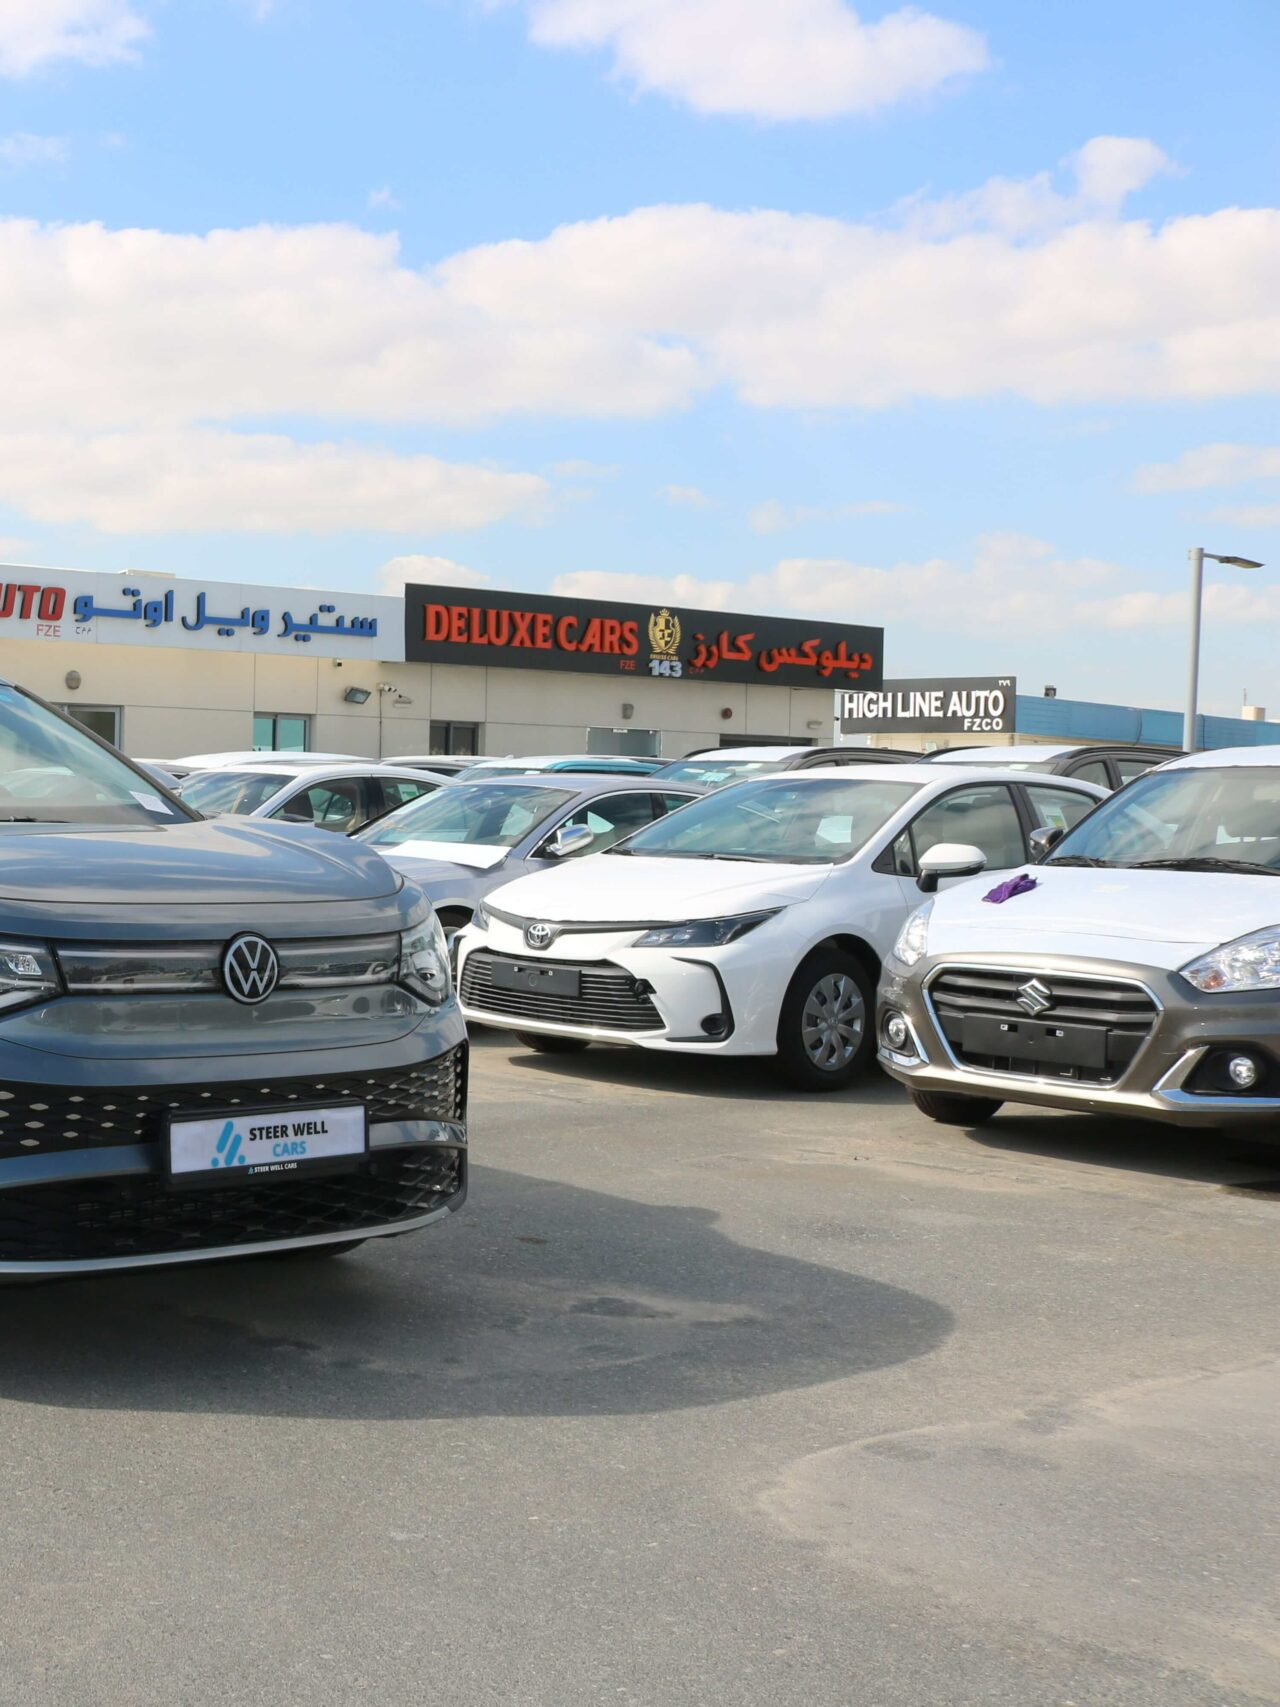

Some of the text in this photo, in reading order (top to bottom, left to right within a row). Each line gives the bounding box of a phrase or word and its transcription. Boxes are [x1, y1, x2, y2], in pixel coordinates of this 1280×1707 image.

[74, 587, 378, 642] ستير ويل اوتو
[36, 624, 62, 638] FZE
[423, 603, 640, 656] DELUXE CARS
[688, 630, 874, 679] ديلوكس كارز
[620, 659, 637, 671] FZE
[648, 659, 683, 678] 143
[843, 689, 1005, 719] HIGH LINE AUTO
[964, 718, 1003, 731] FZCO
[249, 1120, 329, 1142] STEER WELL
[272, 1140, 307, 1158] CARS
[254, 1162, 298, 1173] STEER WELL CARS
